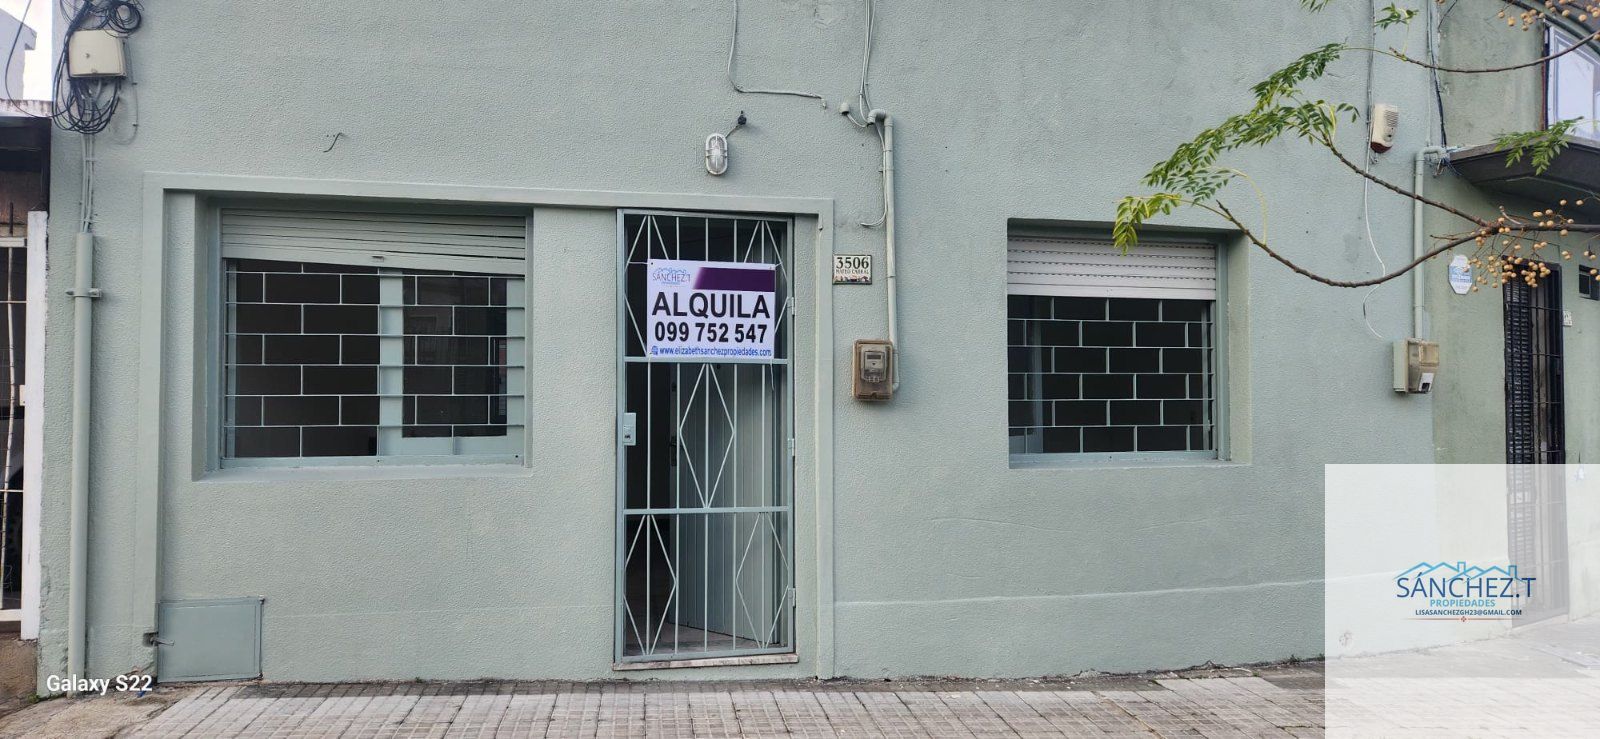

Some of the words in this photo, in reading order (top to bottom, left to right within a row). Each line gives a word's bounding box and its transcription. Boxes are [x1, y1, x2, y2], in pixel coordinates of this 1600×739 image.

[836, 256, 869, 270] 3506
[651, 291, 771, 319] ALQUILA
[654, 321, 690, 342] 099
[695, 322, 729, 343] 752
[734, 323, 768, 344] 547
[659, 345, 772, 358] www.elizabethsanchezpropiedades.com
